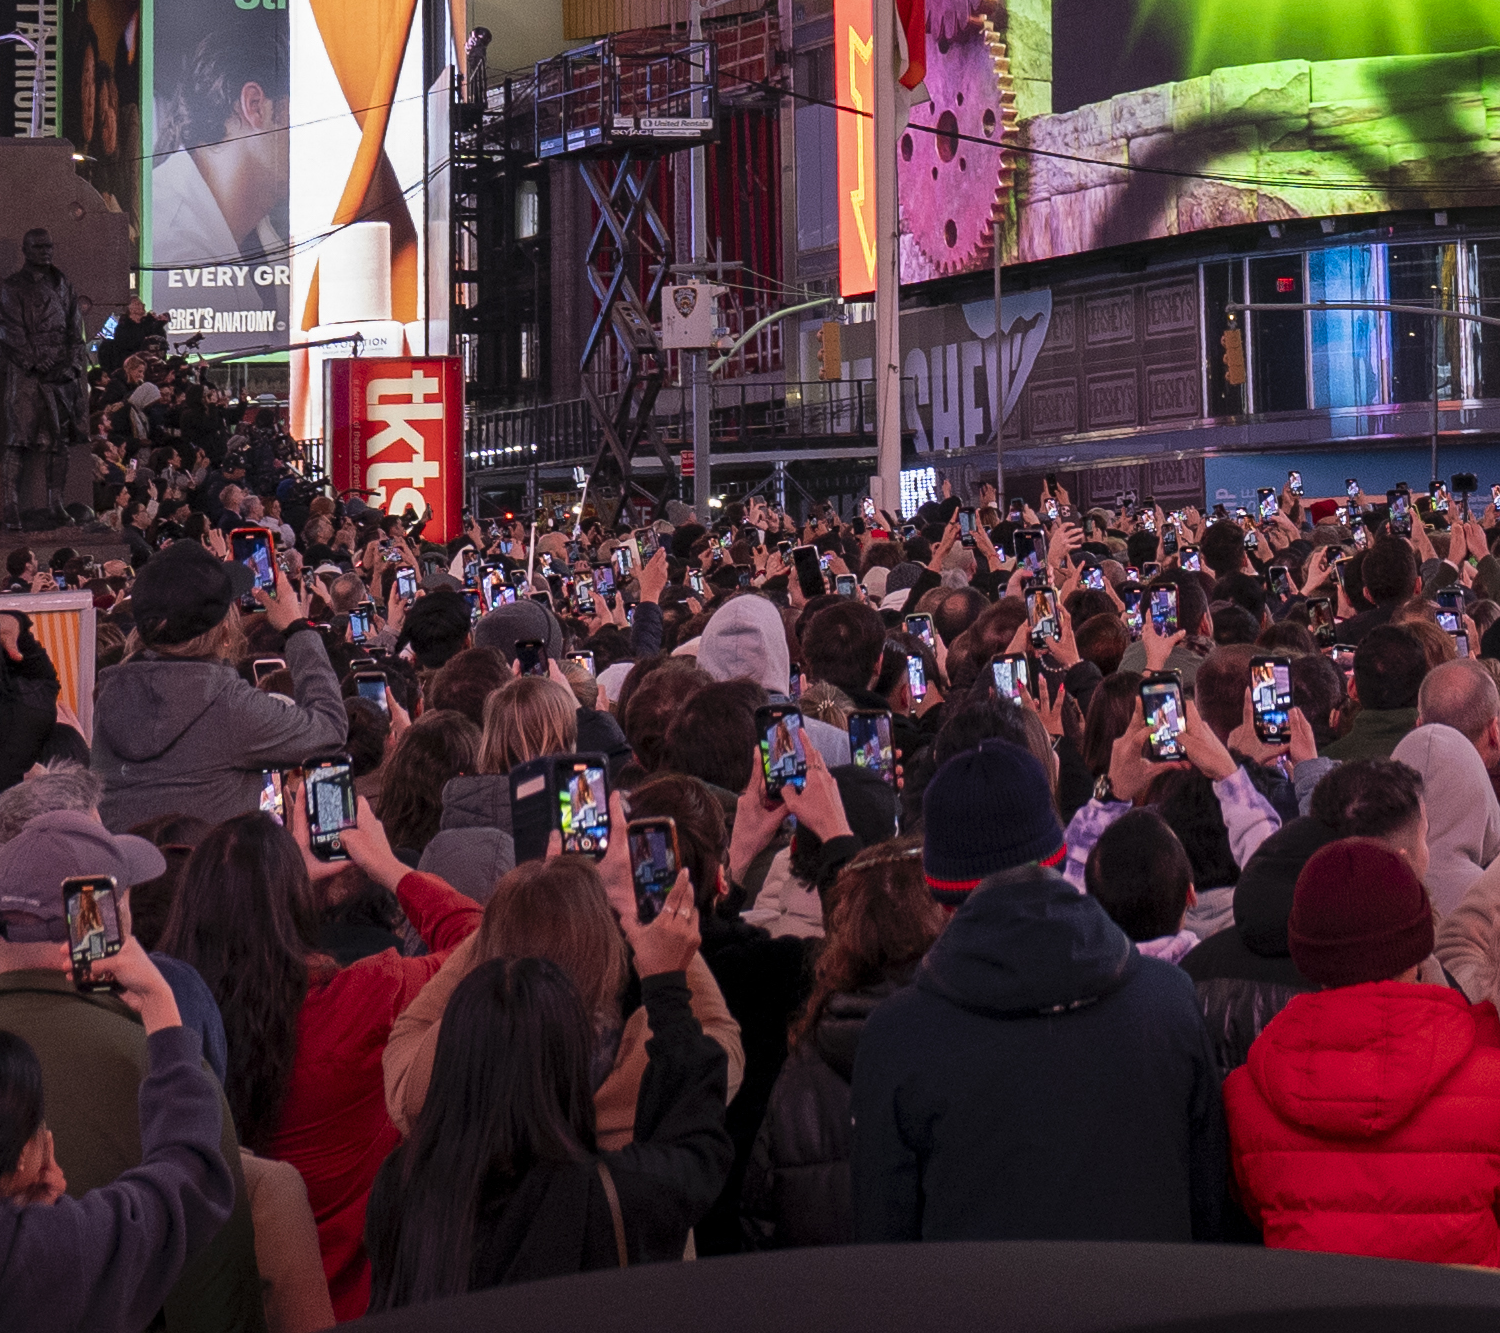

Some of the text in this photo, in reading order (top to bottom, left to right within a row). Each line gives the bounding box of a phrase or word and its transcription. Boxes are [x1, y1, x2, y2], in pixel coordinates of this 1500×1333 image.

[654, 119, 709, 128] United Rentals
[168, 264, 290, 288] EVERY GR
[168, 307, 213, 331] GREY'S
[213, 309, 277, 333] ANATOMY
[351, 387, 362, 418] service
[351, 431, 362, 461] theatre
[366, 369, 444, 534] tkts
[349, 463, 362, 498] develp
